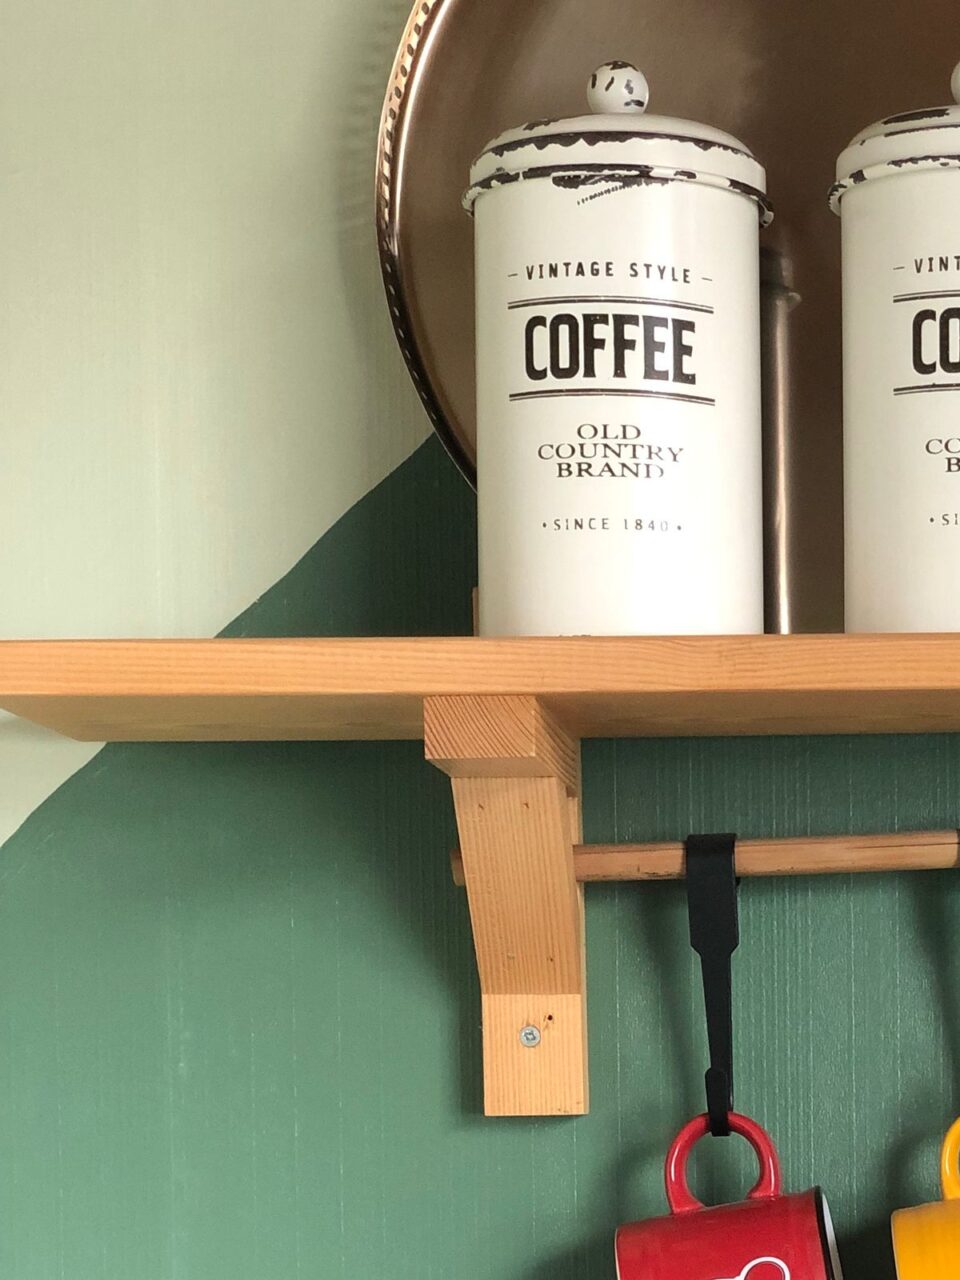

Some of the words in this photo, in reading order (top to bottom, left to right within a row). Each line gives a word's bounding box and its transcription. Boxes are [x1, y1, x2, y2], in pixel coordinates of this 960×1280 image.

[526, 262, 614, 280] VINTAGE
[629, 263, 690, 283] STYLE
[525, 313, 696, 385] COFFEE
[577, 424, 641, 440] OLD
[538, 443, 684, 462] COUNTRY
[556, 462, 664, 478] BRAND
[553, 518, 610, 531] SINCE
[623, 519, 669, 532] 1840
